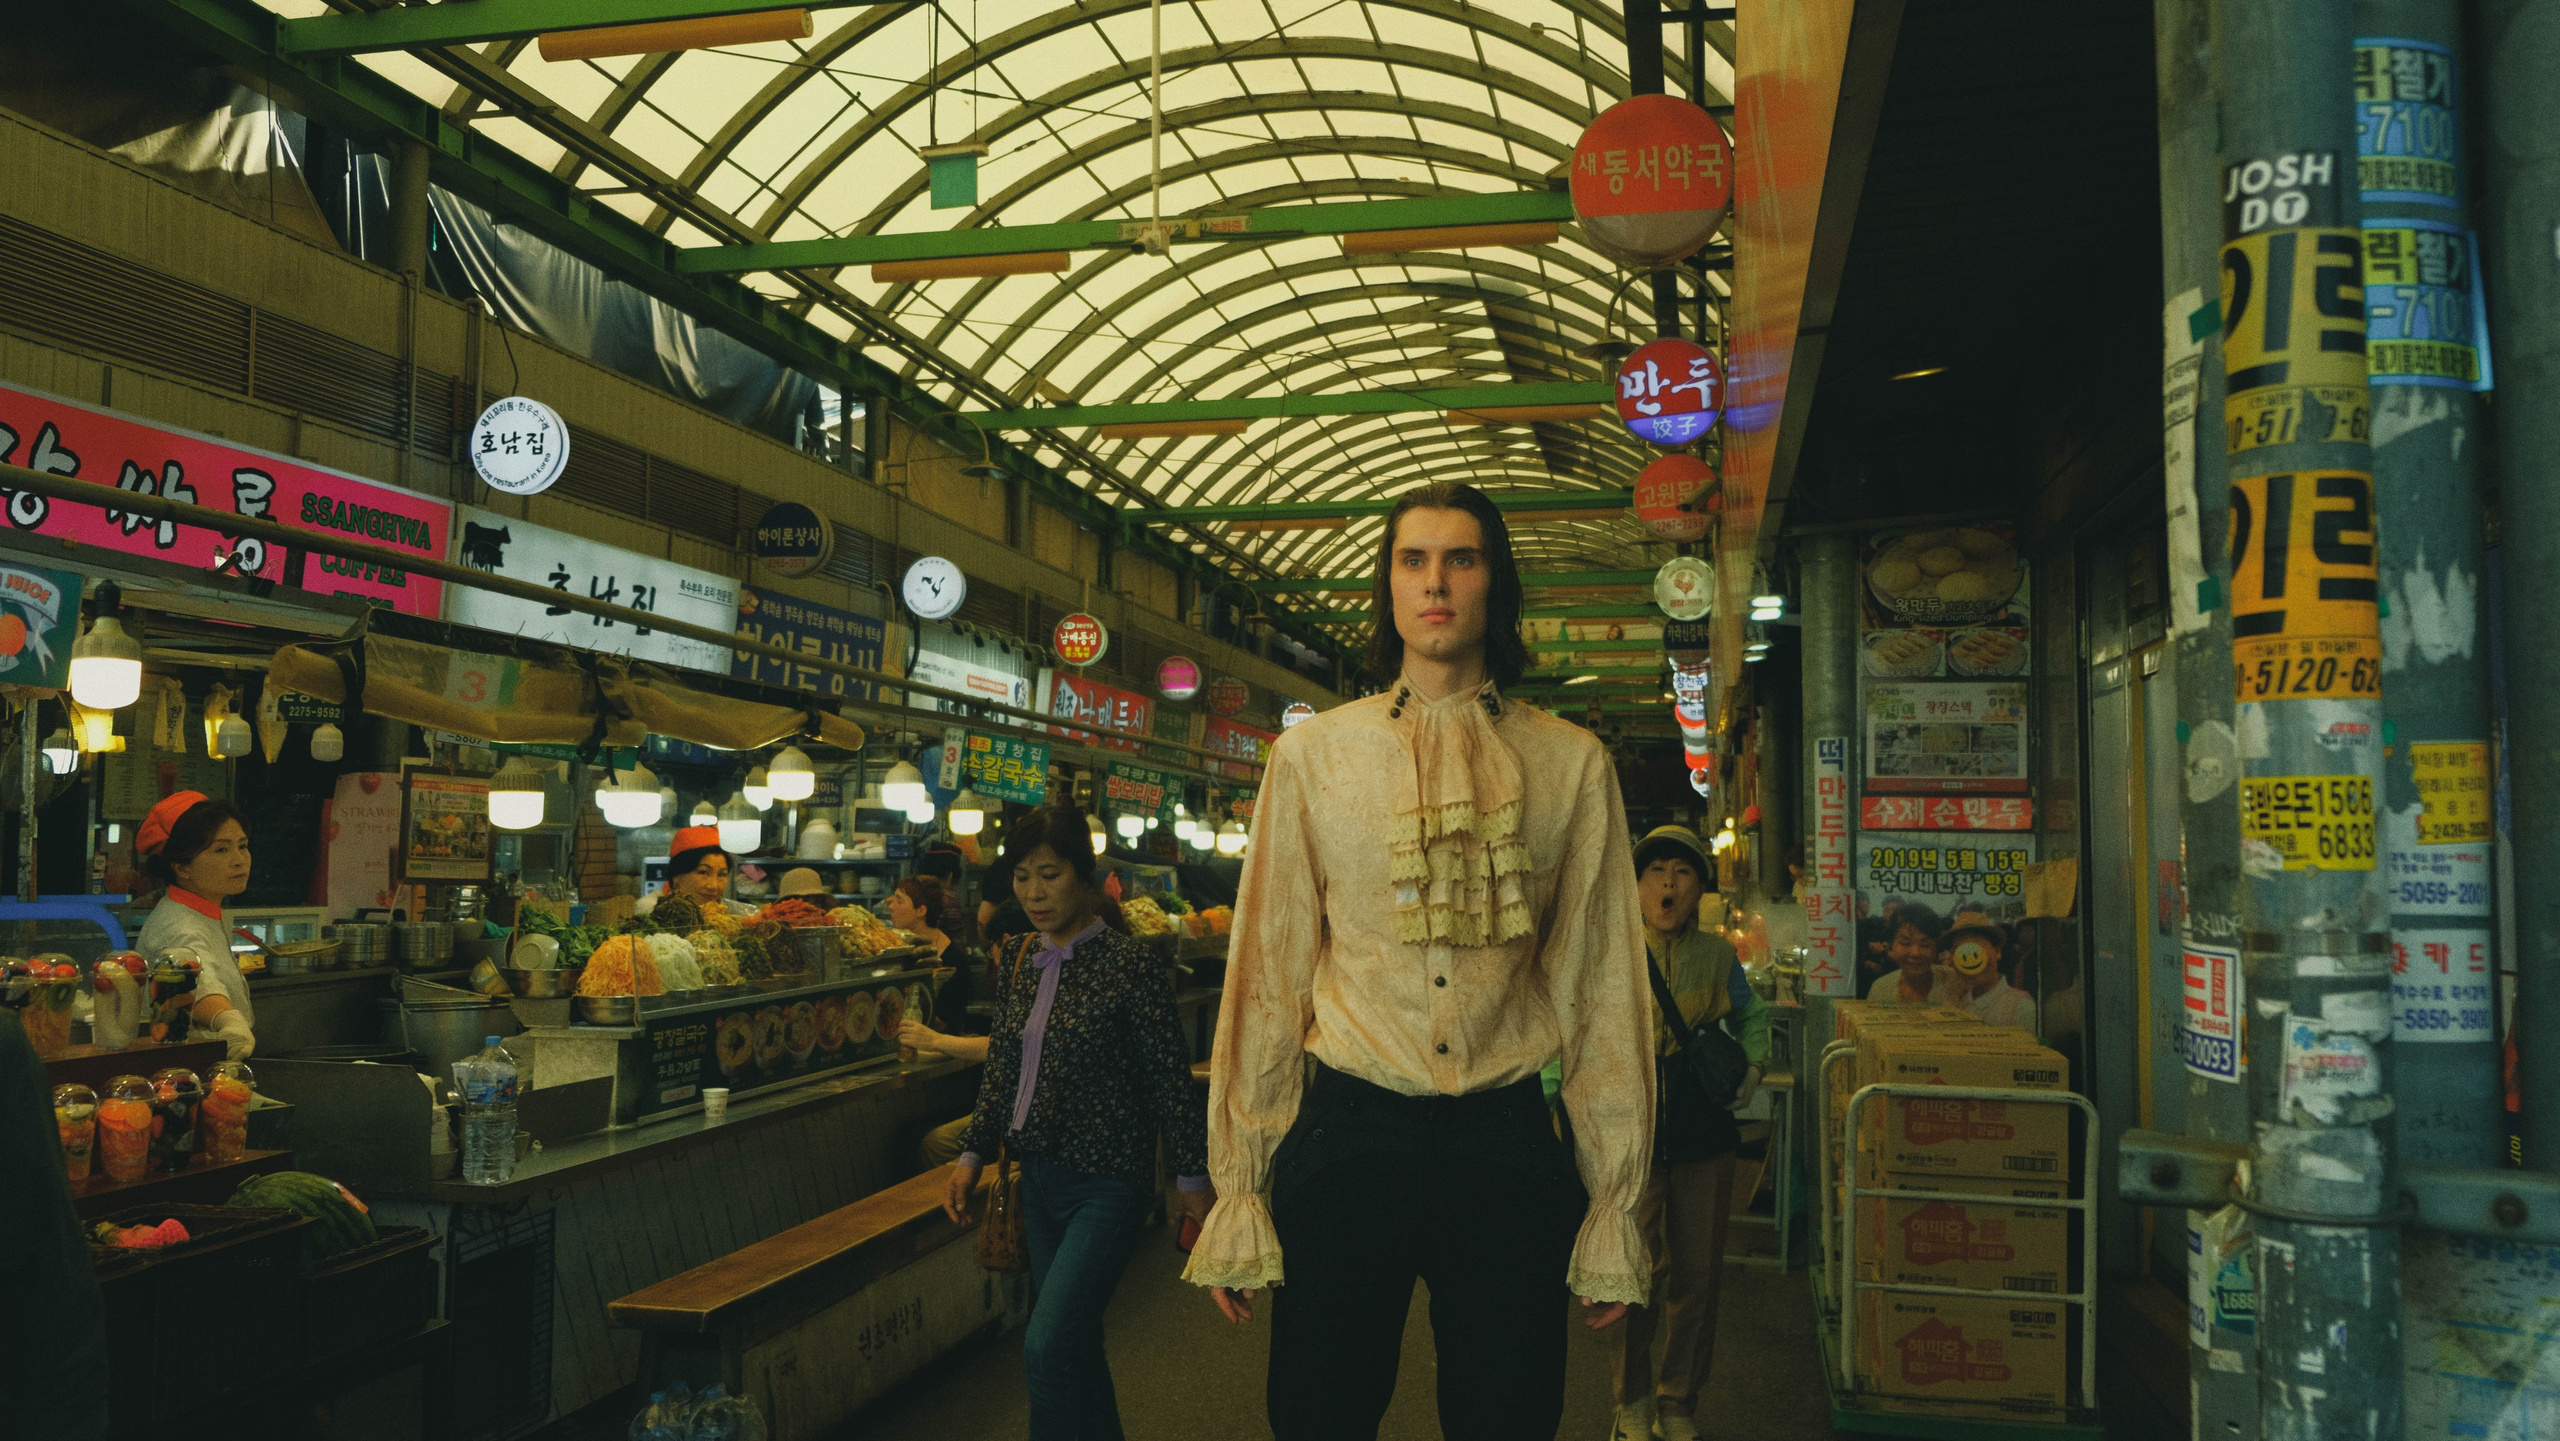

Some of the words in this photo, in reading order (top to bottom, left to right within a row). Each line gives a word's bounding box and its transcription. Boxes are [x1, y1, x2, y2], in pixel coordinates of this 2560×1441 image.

[1578, 144, 1724, 196] 새동서약국
[2224, 153, 2333, 202] JOSH
[1620, 358, 1718, 416] 만두
[1652, 416, 1698, 439] 饺子
[481, 431, 546, 456] 호남집
[481, 469, 493, 481] one
[493, 476, 529, 488] restaurant
[536, 453, 551, 474] Korea
[301, 493, 432, 551] SSANGHWA
[758, 527, 820, 547] 하이론상사
[4, 572, 53, 605] JUICE
[1895, 597, 1941, 612] 왕만두
[1944, 611, 1996, 622] Dumplings
[458, 669, 487, 703] 3
[289, 706, 341, 719] 2275-9592
[945, 747, 957, 763] 3
[995, 740, 1042, 761] 평창집
[962, 752, 1045, 791] 손칼국수
[1818, 738, 1847, 886] 떡만두국
[1867, 797, 2025, 828] 수제손만두
[2314, 780, 2374, 818] 1566
[2319, 823, 2376, 861] 6833
[1871, 848, 1938, 869] 2019년
[1946, 849, 1976, 871] 5월
[1986, 851, 2029, 873] 15일
[1984, 873, 2022, 895] 방영
[1910, 1219, 1963, 1243] 해피홈
[1908, 1339, 1960, 1363] 해피홈
